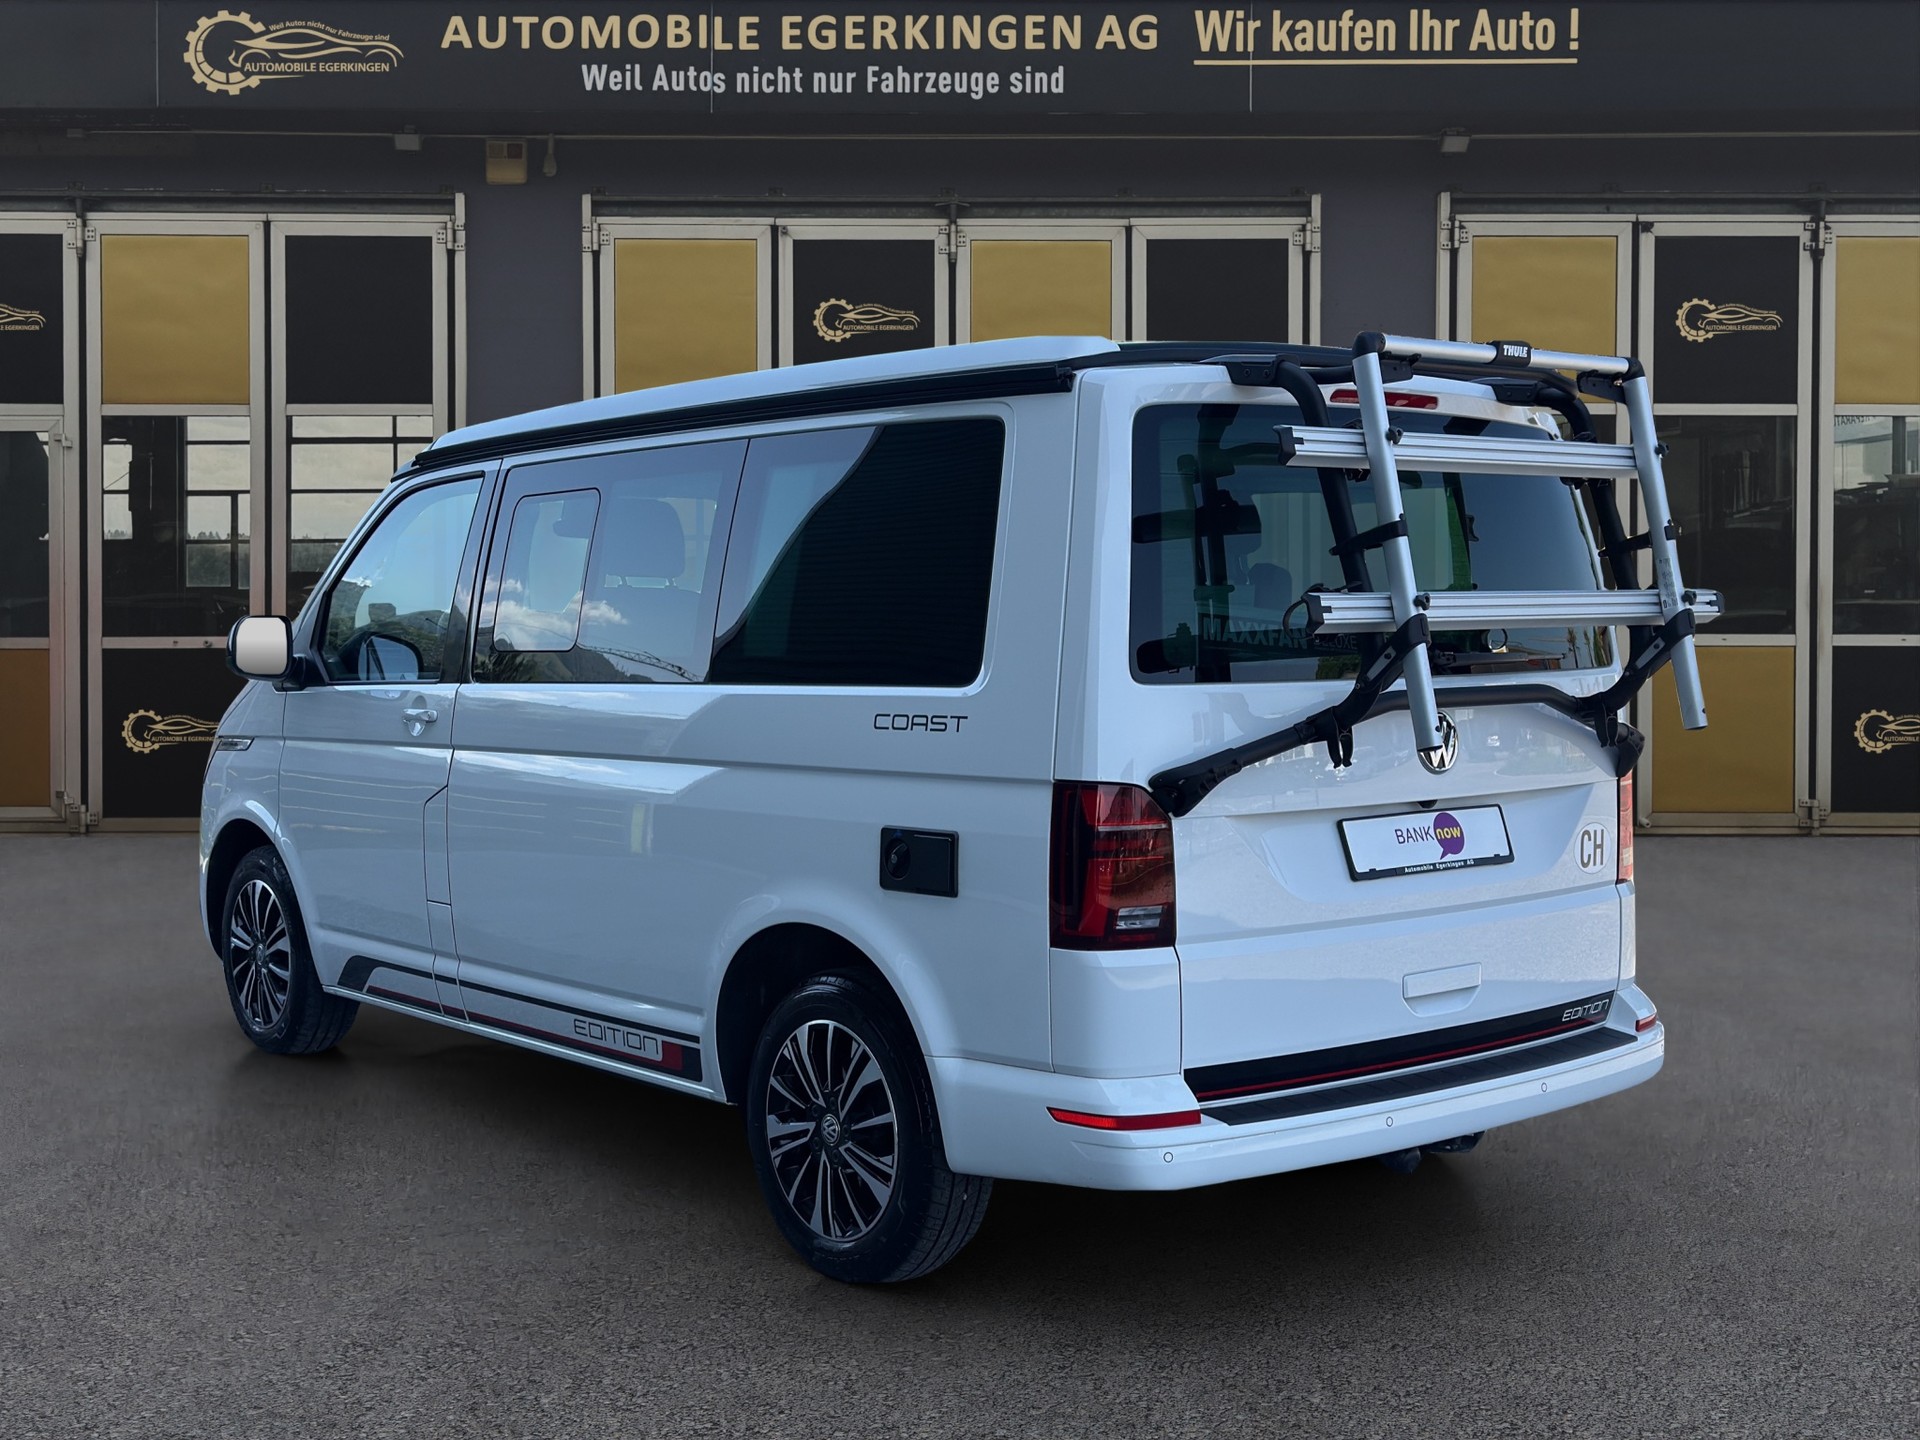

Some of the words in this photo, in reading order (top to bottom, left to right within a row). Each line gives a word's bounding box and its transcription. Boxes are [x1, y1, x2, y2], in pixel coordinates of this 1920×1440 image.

[268, 22, 284, 32] Weil
[285, 20, 306, 28] Autos
[307, 20, 325, 30] nicht
[325, 26, 337, 34] nur
[338, 29, 374, 42] Fahrzeuge
[440, 14, 760, 50] AUTOMOBILE
[781, 15, 1082, 50] EGERKINGEN
[1095, 15, 1158, 50] AG
[1194, 9, 1261, 52] Wir
[1271, 9, 1396, 52] kaufen
[1409, 9, 1460, 51] Ihr
[1468, 8, 1555, 51] Auto
[244, 62, 317, 72] AUTOMOBILE
[319, 62, 390, 72] EGERKINGEN
[581, 64, 643, 91] Weil
[652, 64, 726, 93] Autos
[736, 66, 803, 93] nicht
[813, 72, 856, 93] nur
[867, 65, 1000, 100] Fahrzeuge
[1009, 65, 1064, 93] sind
[1503, 344, 1528, 358] THULE
[1203, 616, 1308, 649] MAXXFAN
[873, 713, 969, 733] COAST
[1394, 826, 1435, 844] BANK
[1436, 826, 1461, 840] now
[1580, 829, 1604, 868] CH
[1404, 864, 1434, 873] Automobile
[1562, 999, 1610, 1022] EDITION
[573, 1018, 659, 1056] EDITION
